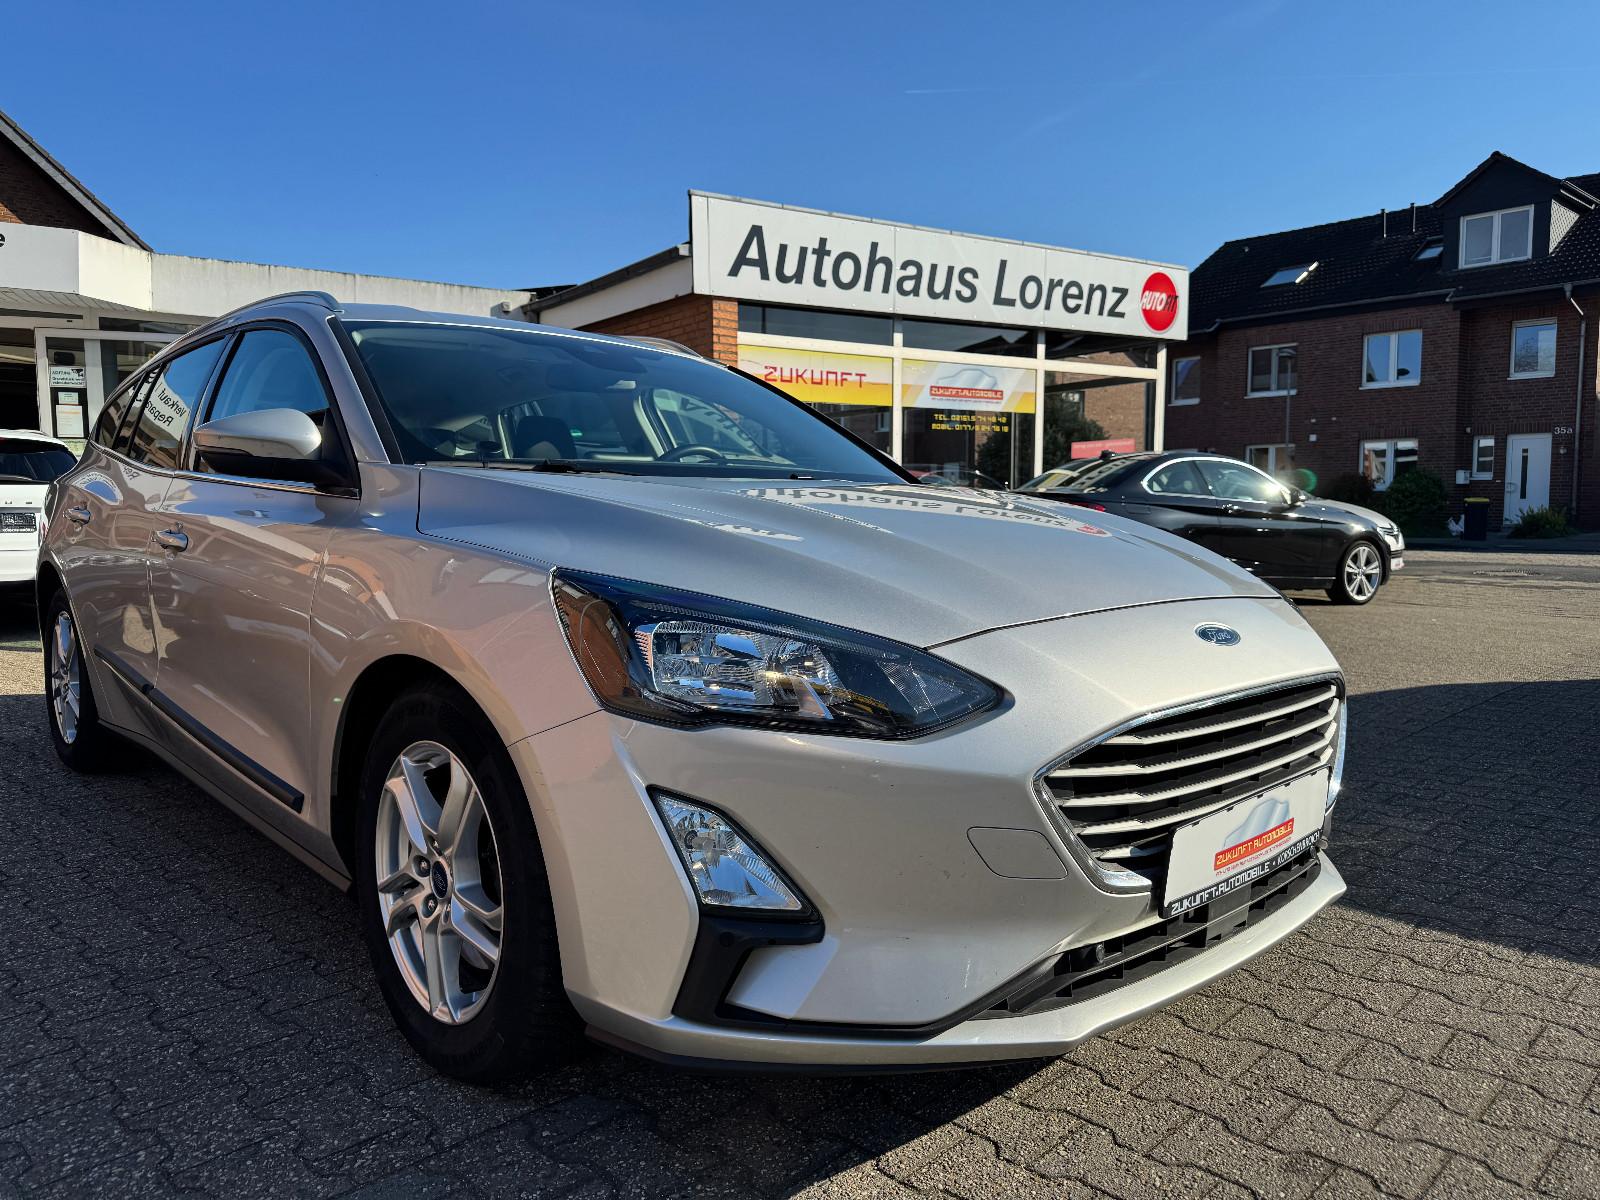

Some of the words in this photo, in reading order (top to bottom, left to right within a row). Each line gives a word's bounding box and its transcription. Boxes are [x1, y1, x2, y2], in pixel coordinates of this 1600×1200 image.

[727, 224, 979, 303] Autohaus
[993, 259, 1129, 319] Lorenz
[764, 365, 867, 389] ZUKUNFT
[1554, 426, 1573, 435] 35a
